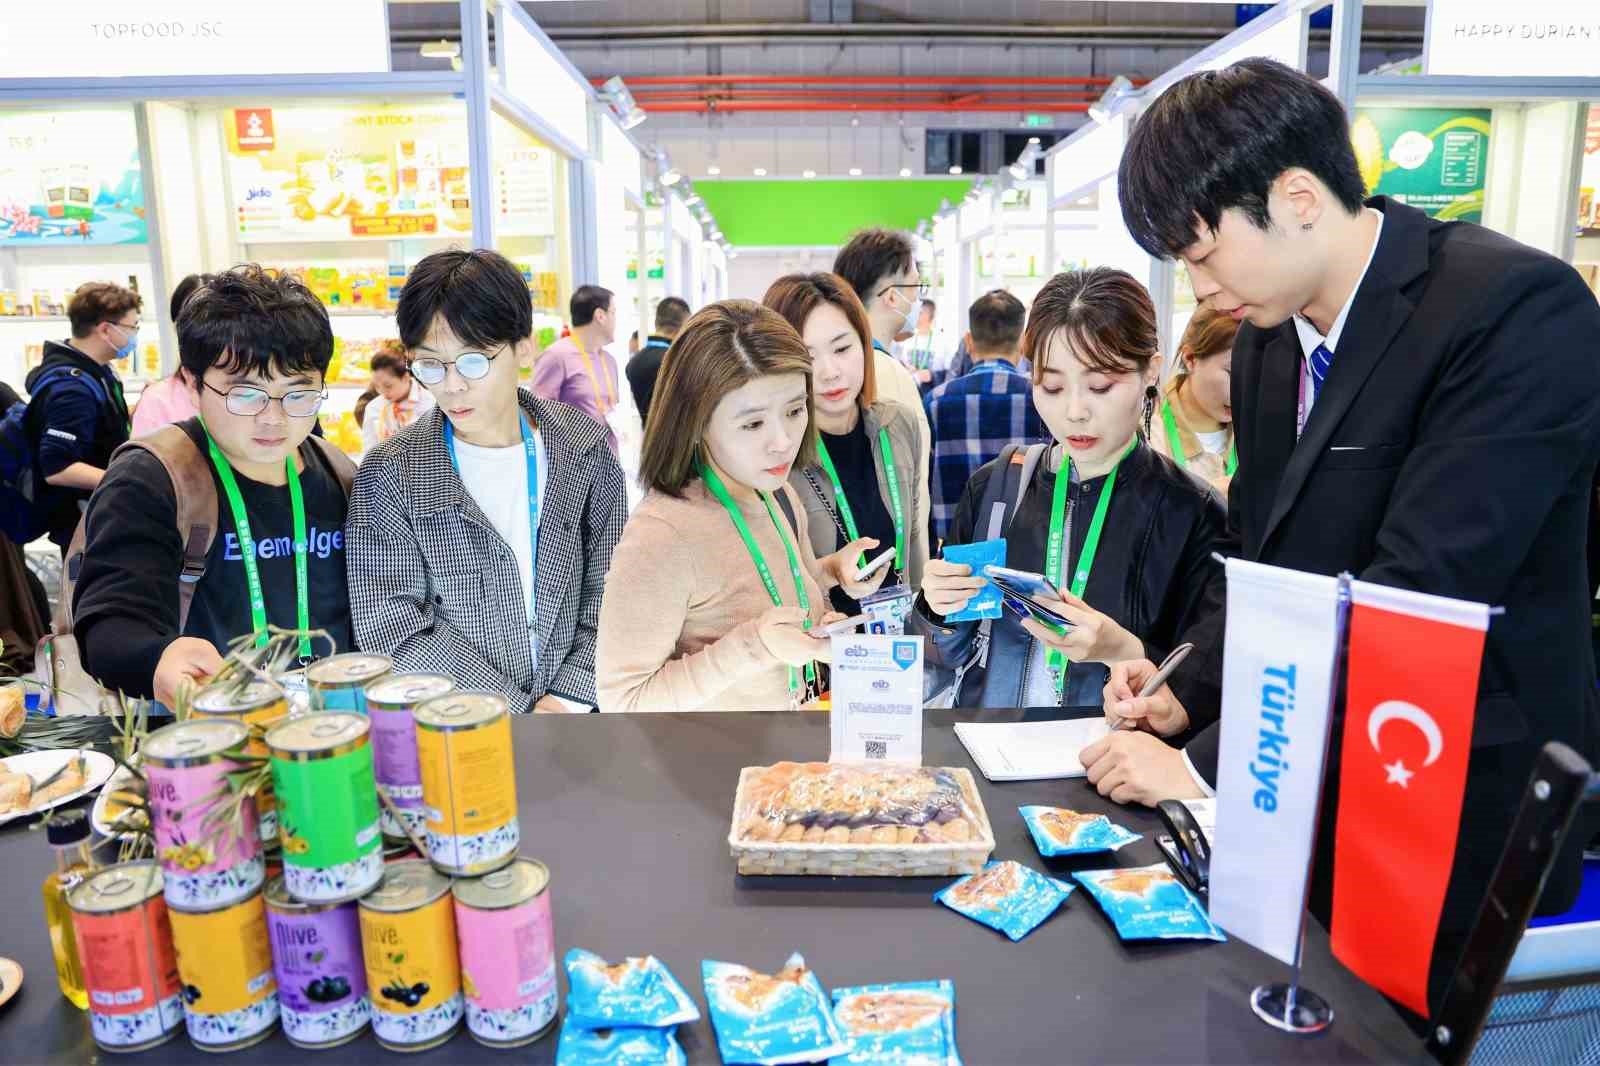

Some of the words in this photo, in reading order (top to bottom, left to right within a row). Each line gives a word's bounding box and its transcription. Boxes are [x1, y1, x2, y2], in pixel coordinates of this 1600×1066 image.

[89, 22, 184, 39] TOPFOOD
[191, 21, 223, 39] JSC
[1454, 23, 1515, 39] HAPPY
[1519, 23, 1591, 39] DURIAN
[1248, 664, 1297, 814] Türkiye
